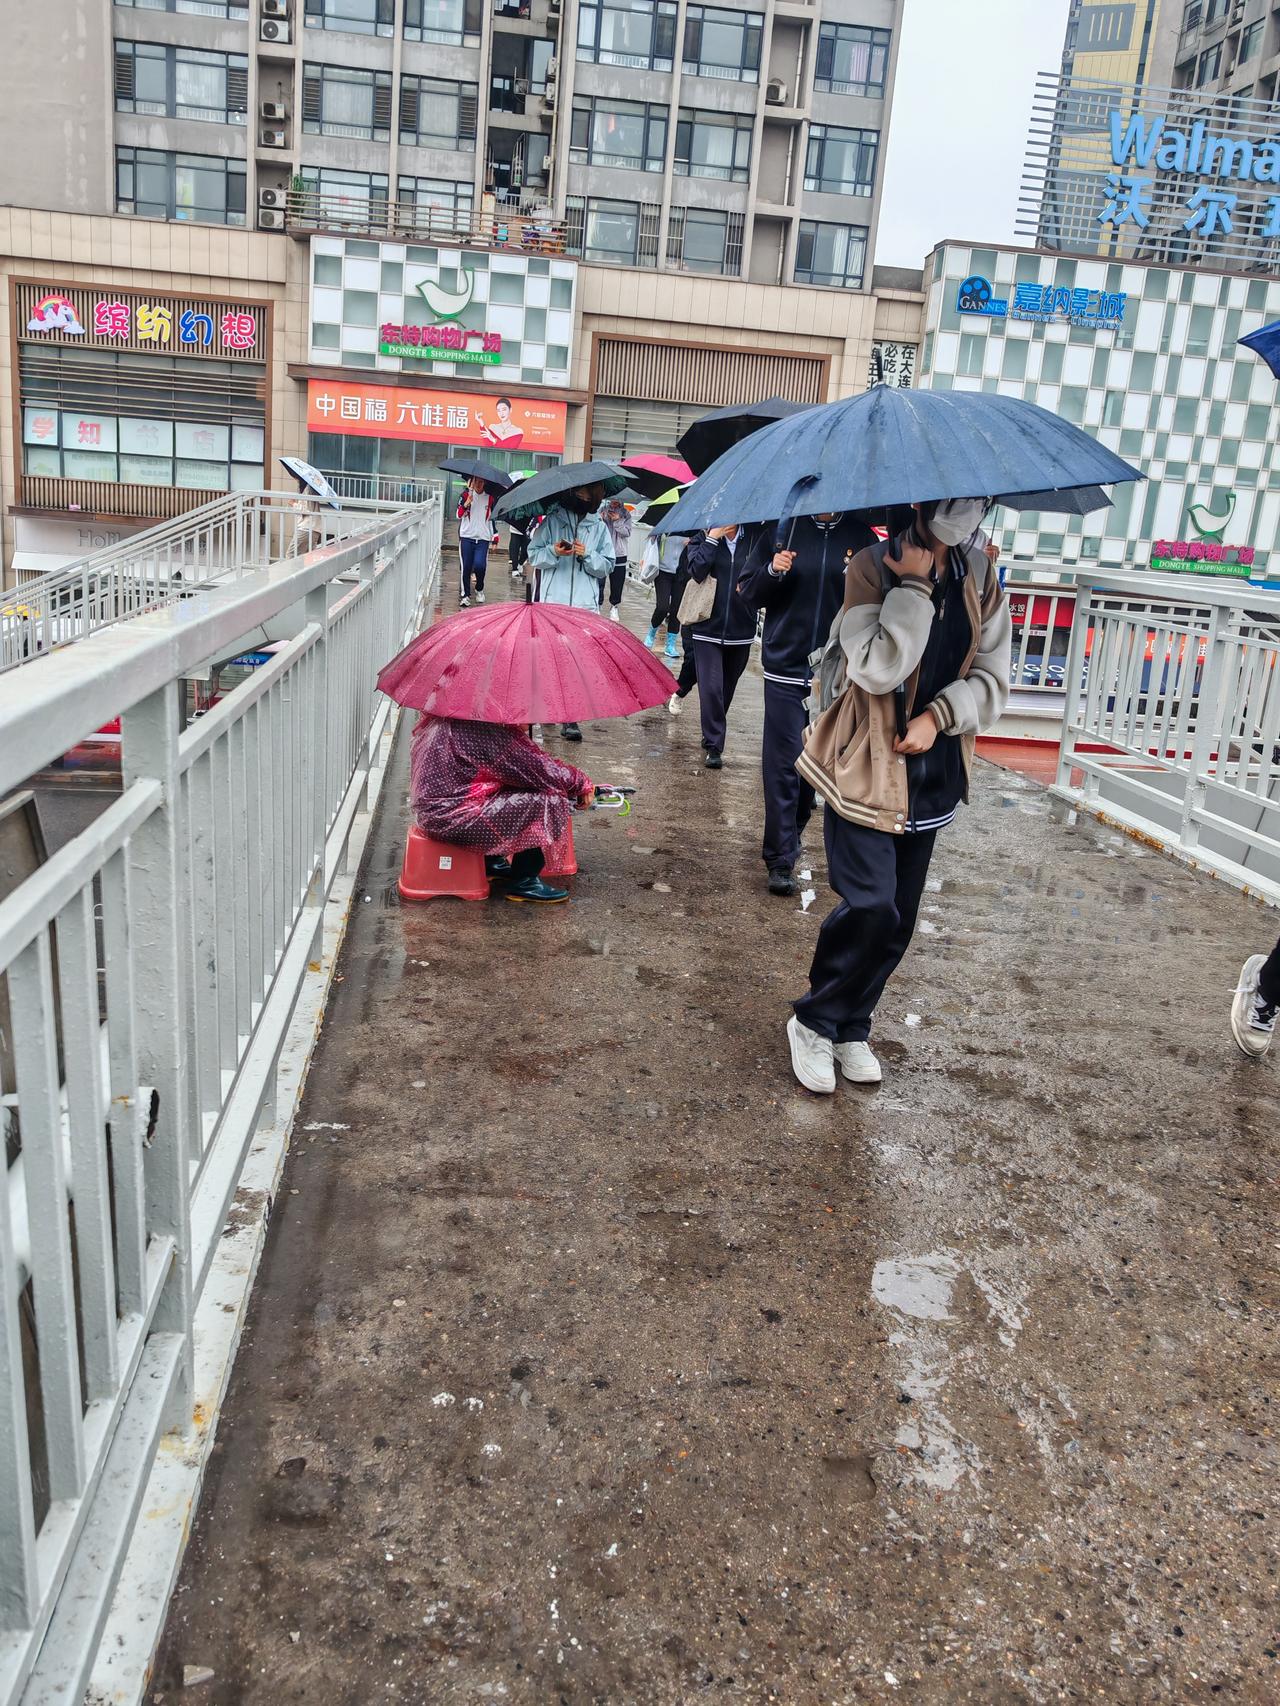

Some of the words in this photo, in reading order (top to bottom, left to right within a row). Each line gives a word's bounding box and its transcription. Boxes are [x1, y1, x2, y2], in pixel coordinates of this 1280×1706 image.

[1013, 281, 1127, 321] 嘉纳影城
[94, 300, 256, 350] 缤纷幻想
[381, 323, 502, 353] 东特购物广场
[389, 345, 427, 357] DONGTE
[430, 349, 470, 361] SHOPPING
[471, 354, 494, 363] MALL
[883, 344, 898, 373] 必吃
[897, 345, 916, 389] 在大连
[316, 393, 387, 422] 中国福
[396, 400, 469, 429] 六桂福
[1153, 539, 1254, 565] 东特购物广场
[1159, 560, 1191, 571] DONGTE
[1194, 563, 1226, 573] SHOPPING
[1227, 566, 1245, 575] MALL
